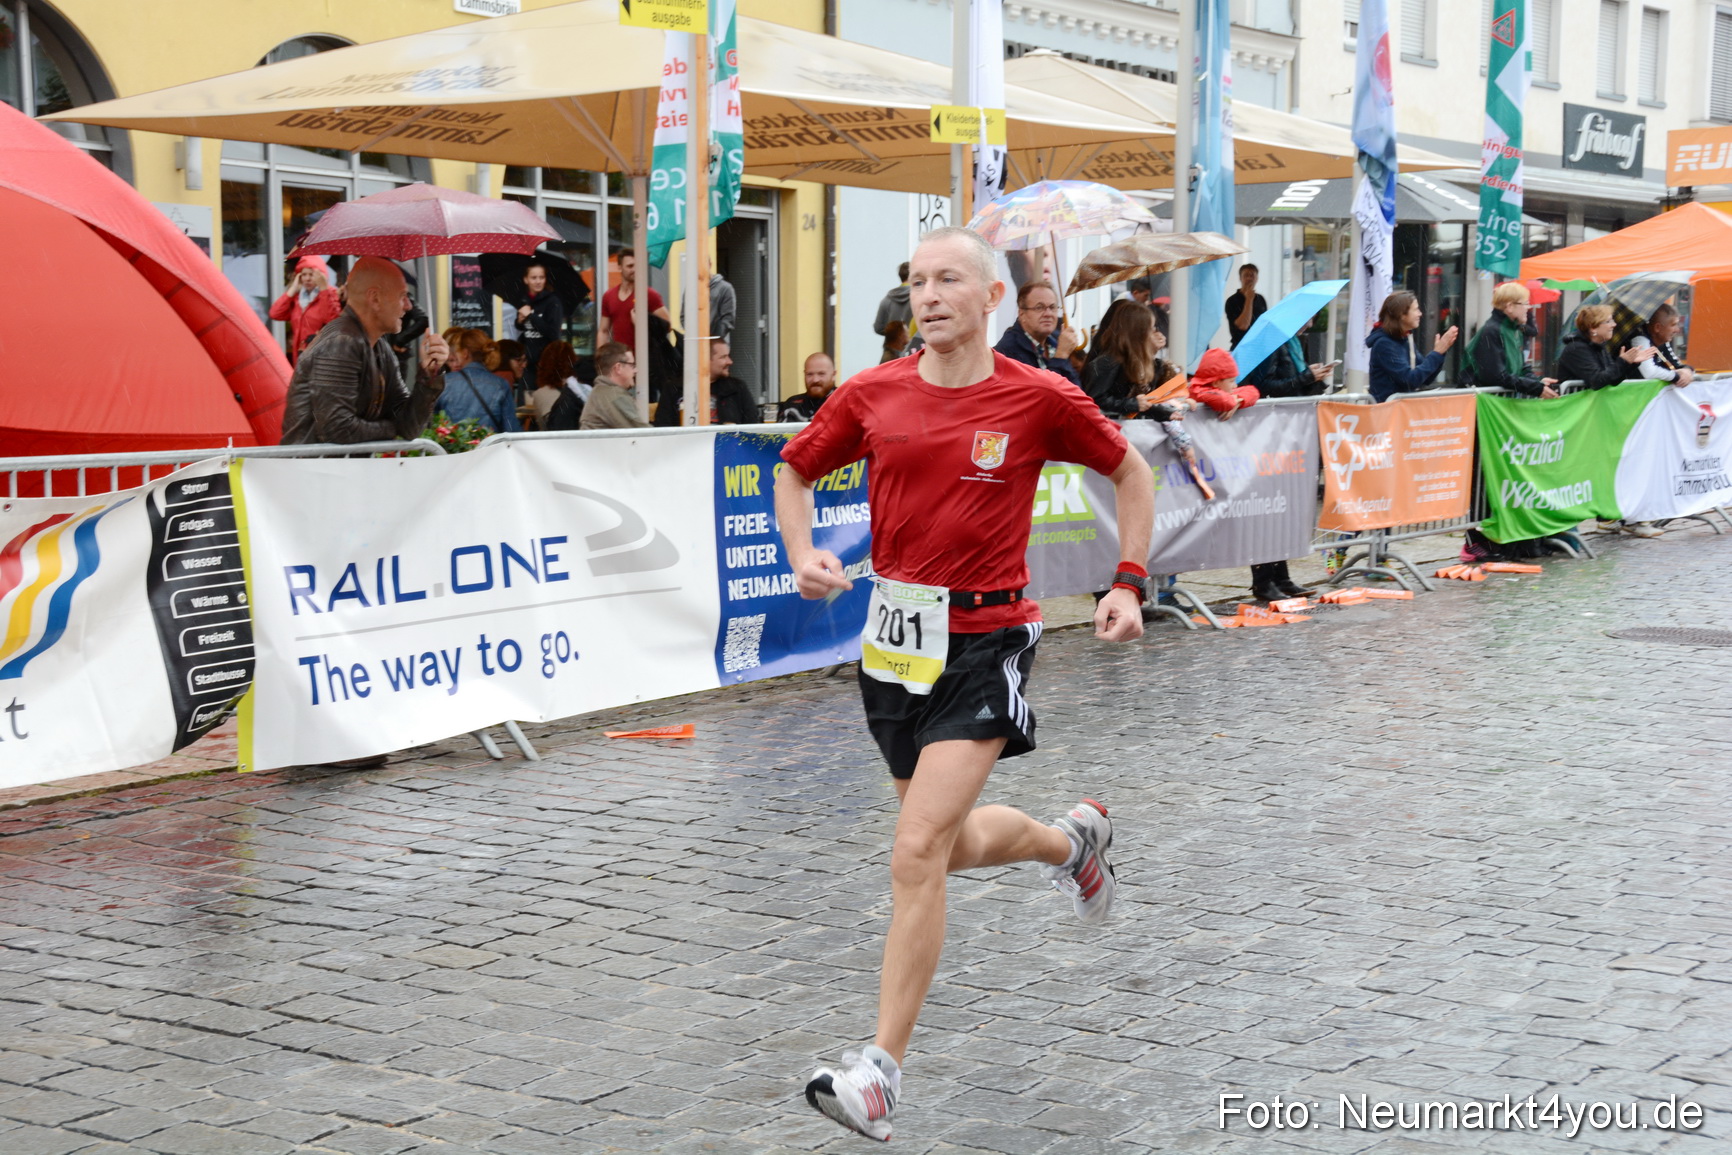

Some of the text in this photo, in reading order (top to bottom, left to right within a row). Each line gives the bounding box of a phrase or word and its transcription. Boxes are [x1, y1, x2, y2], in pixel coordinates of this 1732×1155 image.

[651, 11, 692, 27] ausgabe
[946, 112, 994, 126] Kleiderbeel-
[802, 214, 816, 231] 24
[1164, 456, 1251, 488] INUSTRY
[1252, 449, 1306, 476] LOUNGE
[181, 482, 209, 494] Strom
[723, 459, 867, 498] WIR SHEN
[1032, 473, 1089, 517] CK
[1501, 479, 1593, 511] Wkommen
[178, 517, 215, 532] Erdgas
[724, 512, 770, 537] FREIE
[1042, 525, 1097, 545] concepts
[181, 554, 223, 570] Wasser
[725, 543, 778, 569] UNTER
[727, 573, 801, 602] NEUMARK
[893, 584, 938, 603] BOCK
[190, 593, 229, 608] Wärme
[875, 604, 922, 650] 201
[198, 630, 236, 645] Freizeit
[298, 630, 580, 706] The way to go.
[884, 657, 911, 676] rst
[194, 668, 246, 686] Stadtbusse
